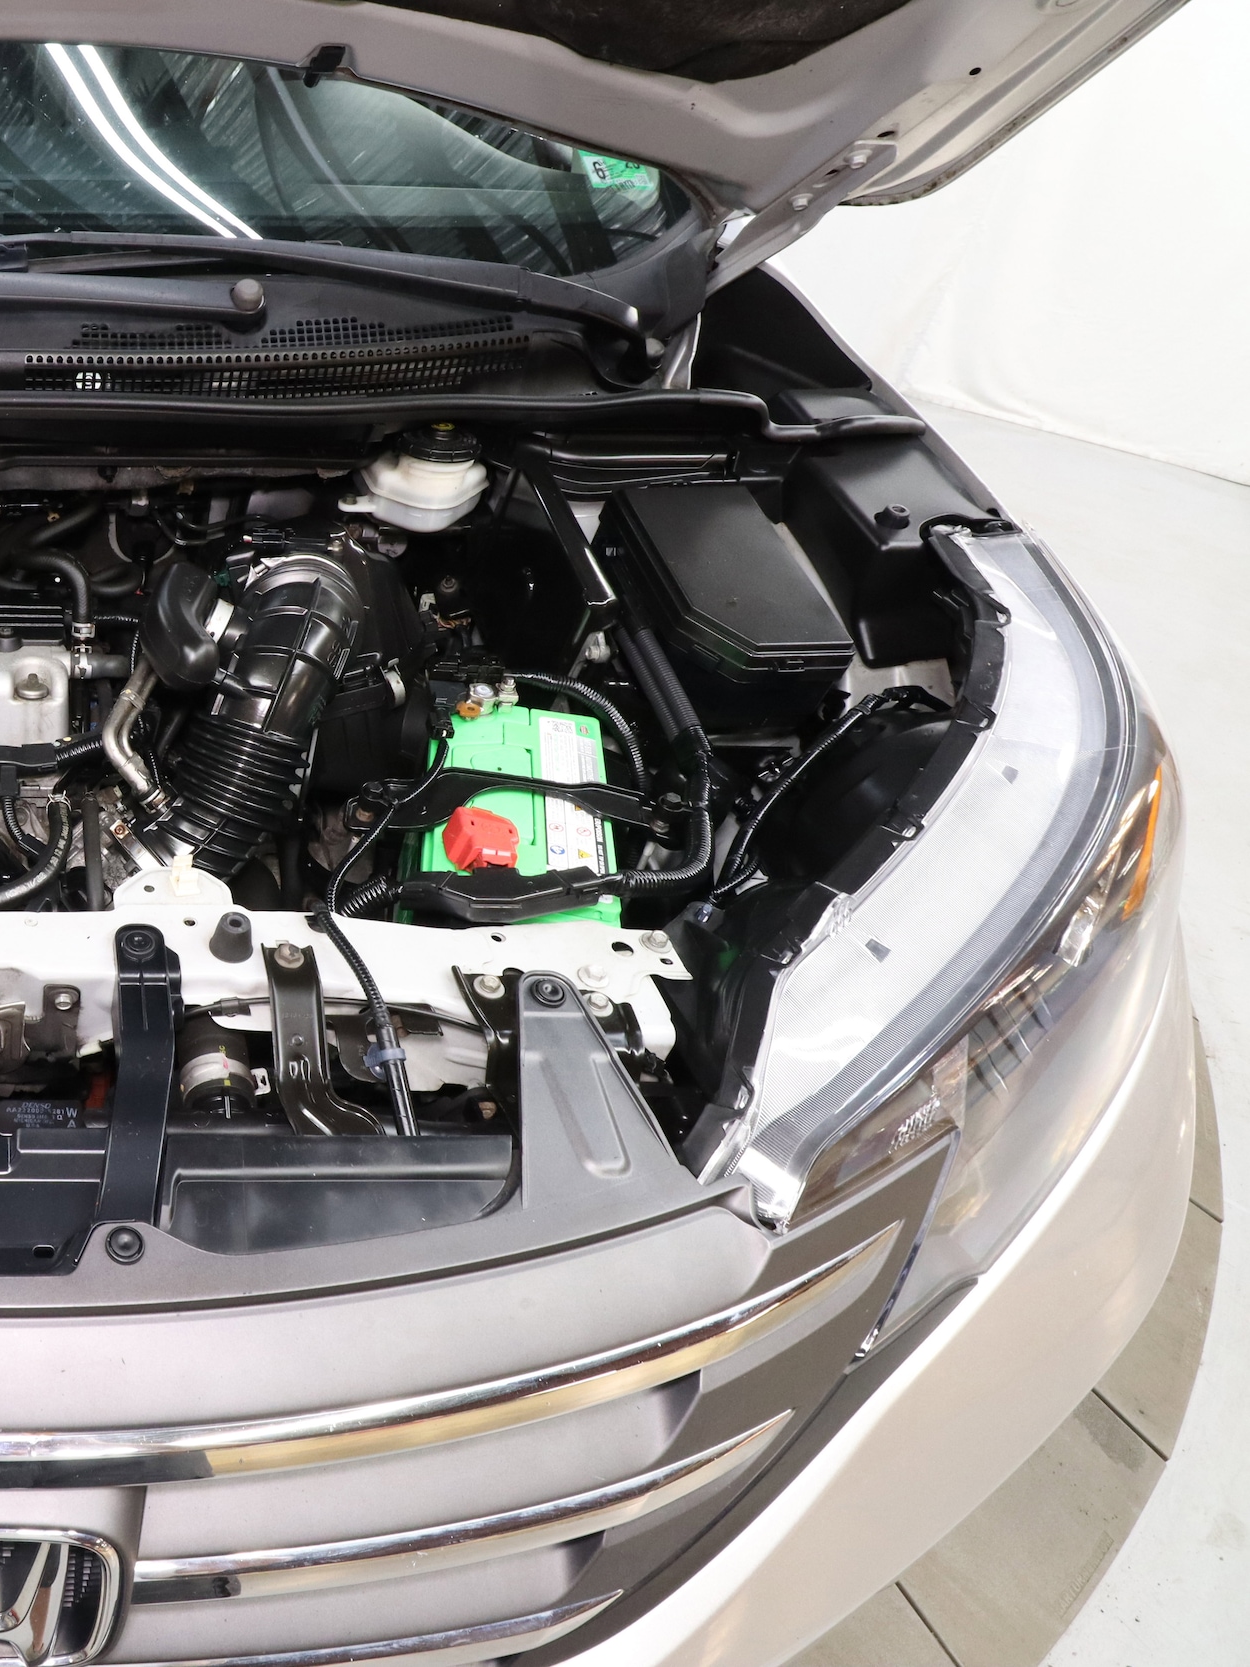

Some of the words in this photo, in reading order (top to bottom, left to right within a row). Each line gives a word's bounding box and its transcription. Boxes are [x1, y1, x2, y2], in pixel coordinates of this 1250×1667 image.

[592, 161, 606, 180] 6
[21, 1101, 52, 1110] DENSO
[66, 1107, 78, 1118] W
[67, 1119, 77, 1128] A
